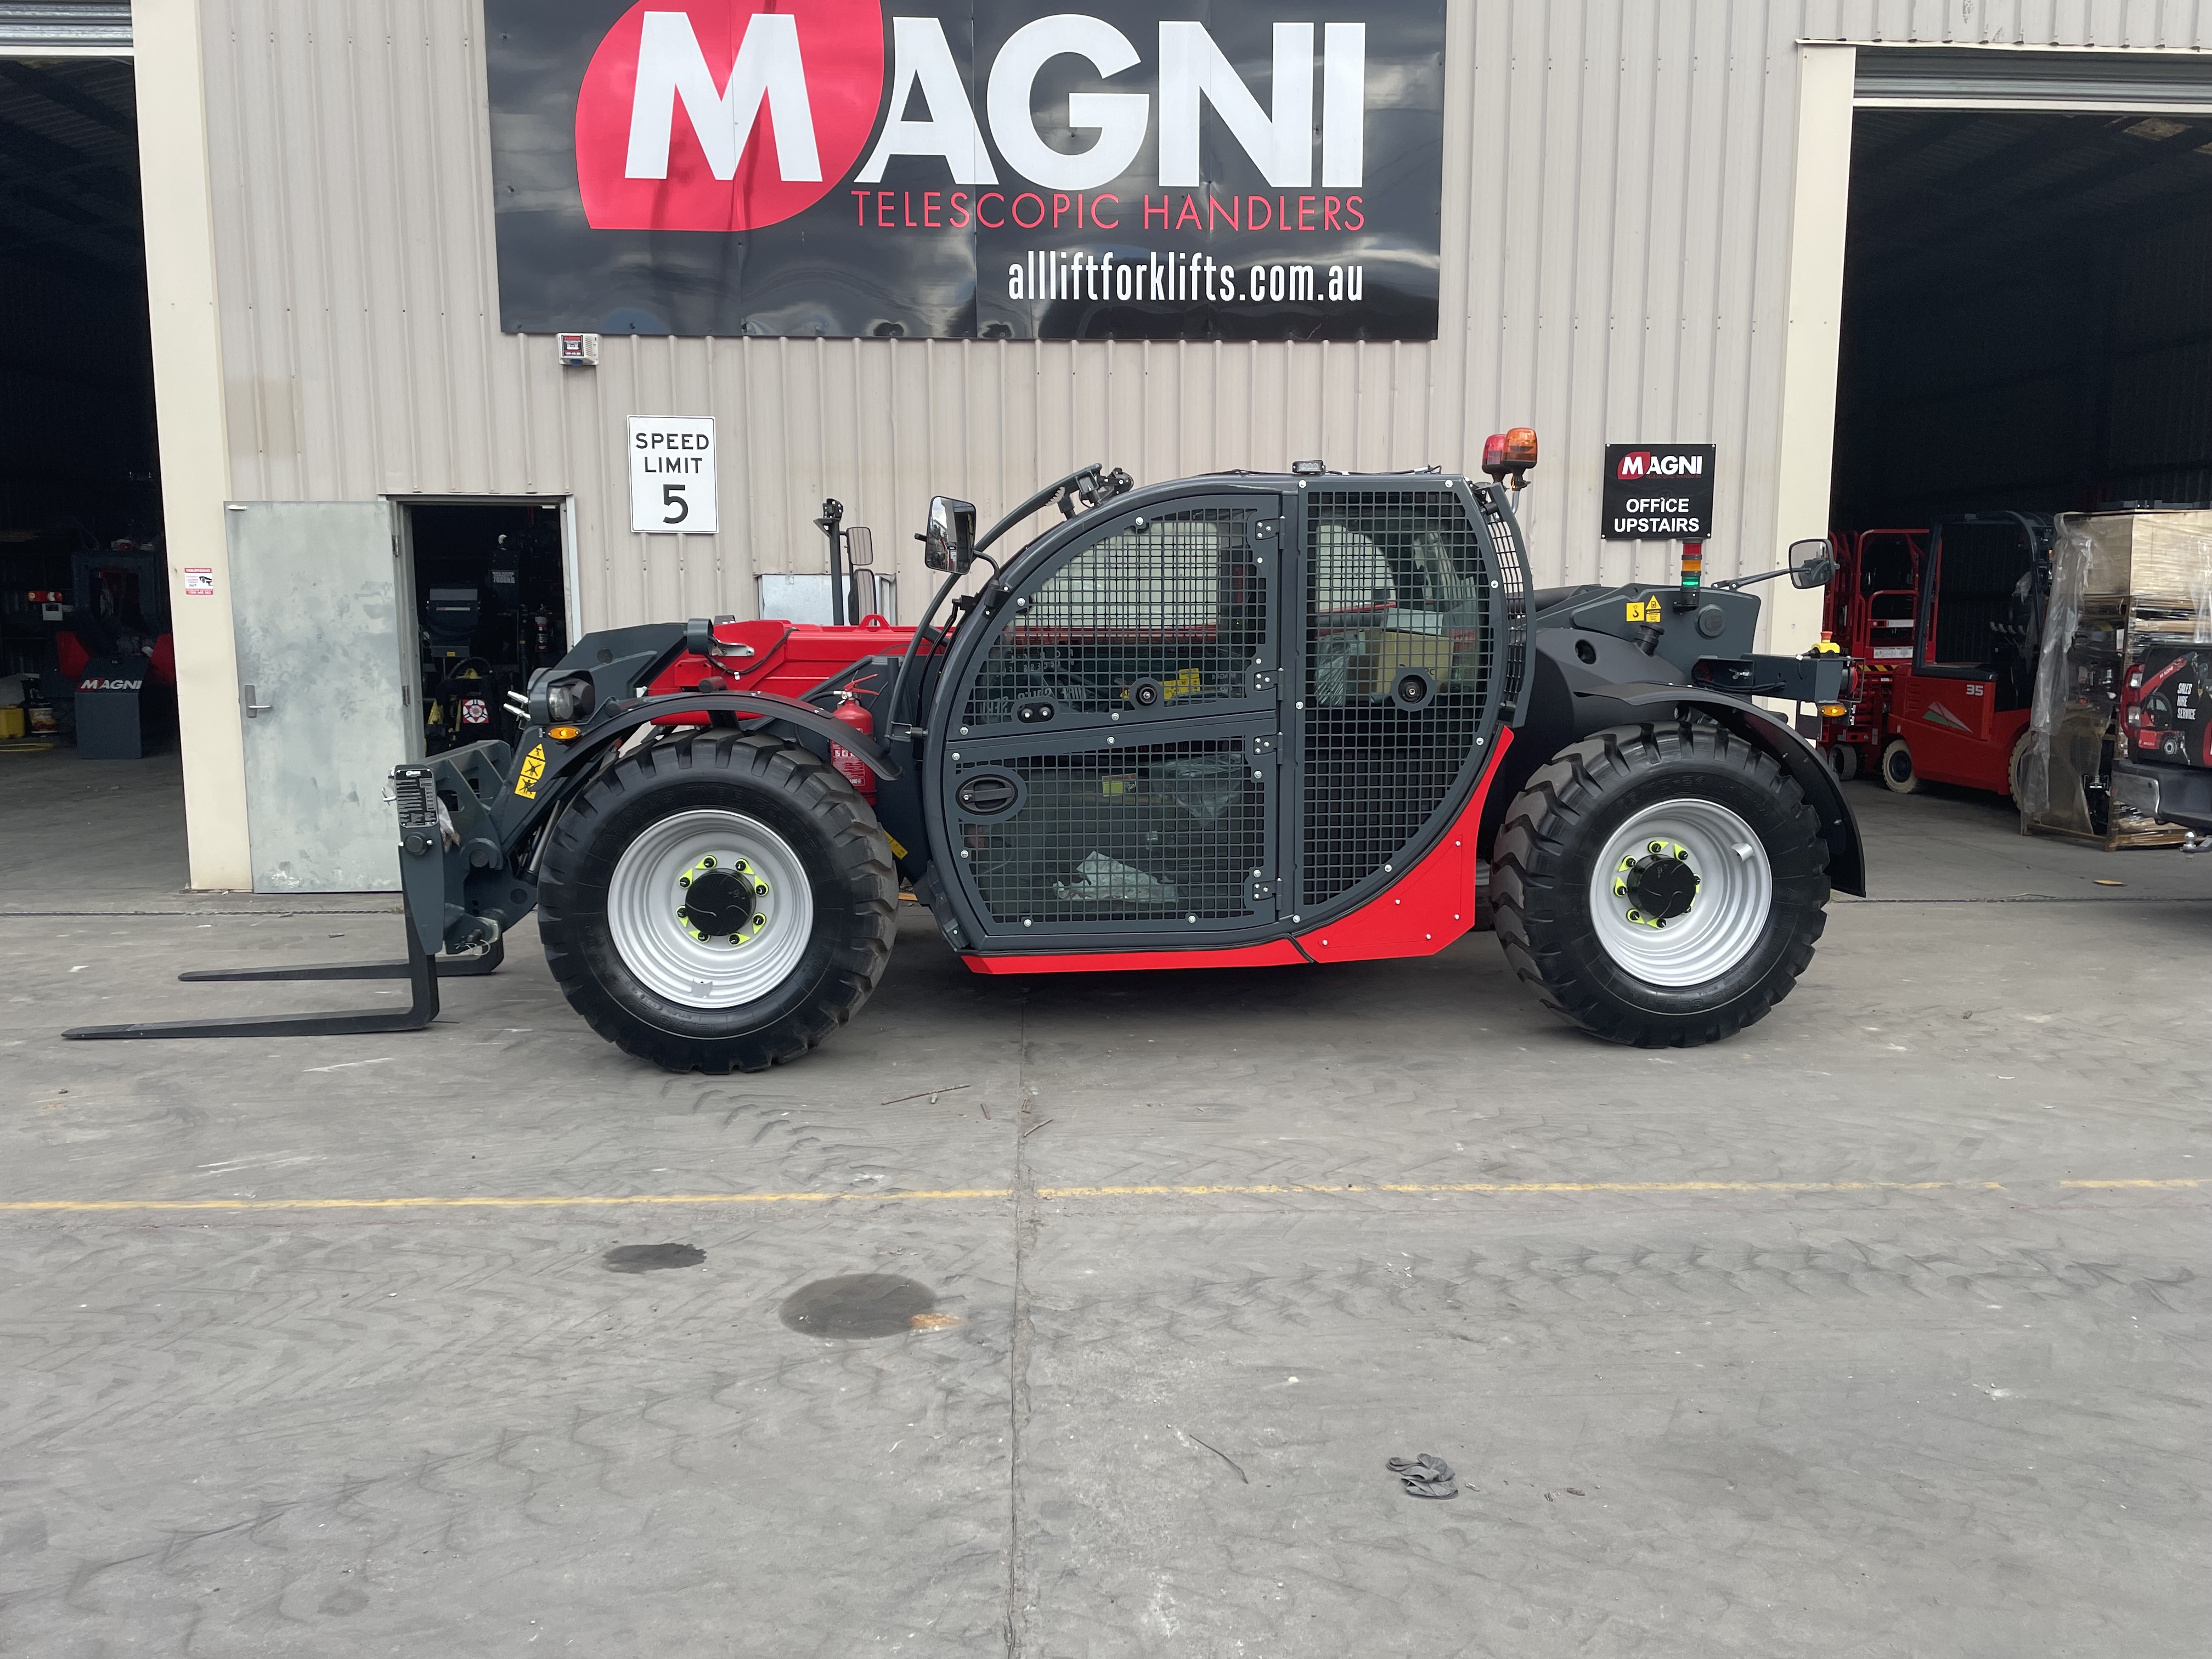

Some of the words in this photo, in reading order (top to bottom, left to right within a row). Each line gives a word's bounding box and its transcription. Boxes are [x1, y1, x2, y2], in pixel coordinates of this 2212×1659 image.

[625, 12, 1366, 190] MAGNI
[852, 190, 1119, 231] TELESCOPIC
[1143, 194, 1365, 232] HANDLERS
[1008, 250, 1363, 303] allliftforklifts.com.au
[636, 433, 709, 450] SPEED
[645, 457, 702, 473] LIMIT
[1622, 456, 1702, 475] MAGNI
[663, 484, 689, 524] 5
[1626, 498, 1689, 513] OFFICE
[1614, 518, 1700, 532] UPSTAIRS
[81, 680, 143, 690] MAGNI
[1966, 685, 1983, 695] 35
[2177, 682, 2193, 695] SALES
[2176, 696, 2188, 707] HIRE
[2177, 708, 2196, 720] SERVICE
